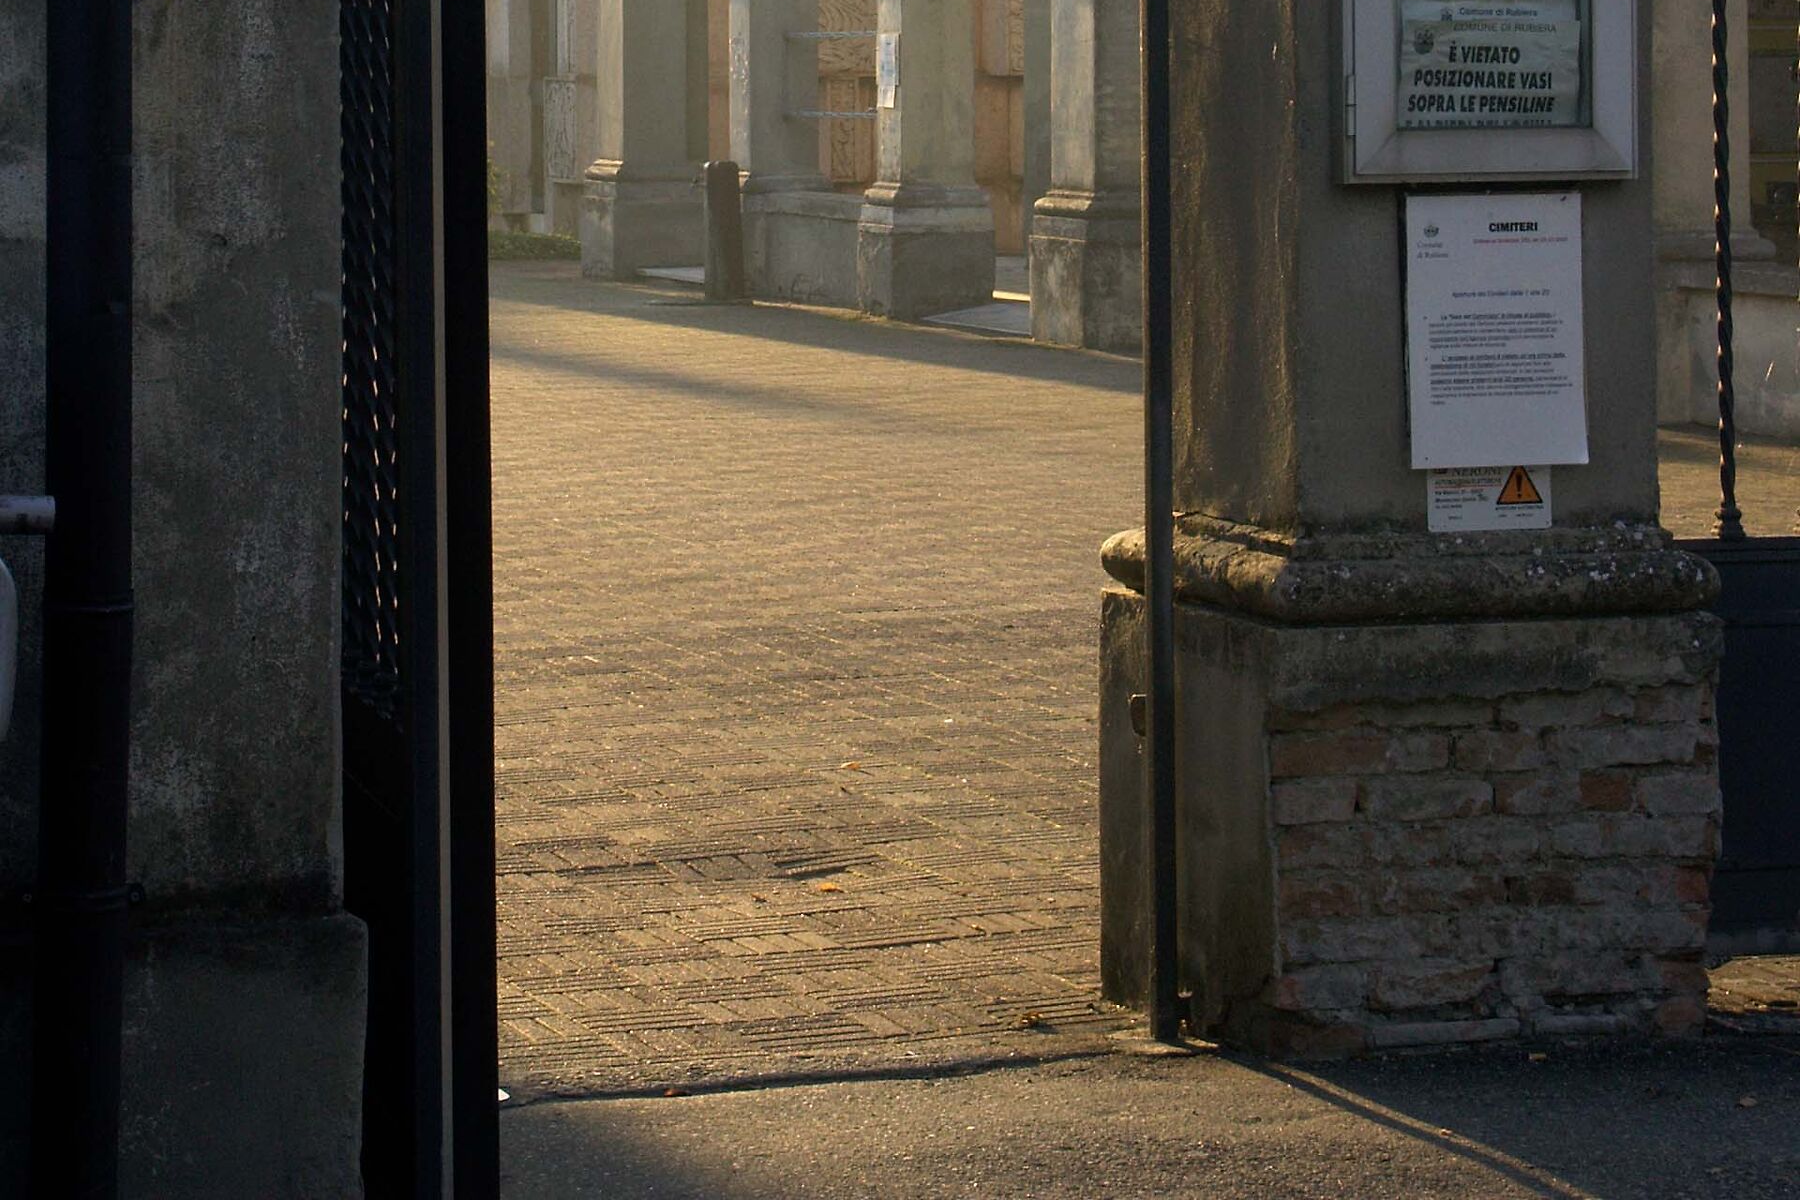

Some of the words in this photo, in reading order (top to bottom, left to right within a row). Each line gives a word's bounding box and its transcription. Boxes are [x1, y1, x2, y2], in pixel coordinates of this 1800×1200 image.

[1461, 46, 1520, 64] VIETATO
[1414, 69, 1515, 89] POSIZIONARE
[1520, 72, 1552, 89] VASI
[1407, 94, 1456, 112] SOPRA
[1460, 96, 1475, 112] LE
[1479, 96, 1555, 113] PENSILINE
[1489, 222, 1538, 232] CIMITERI
